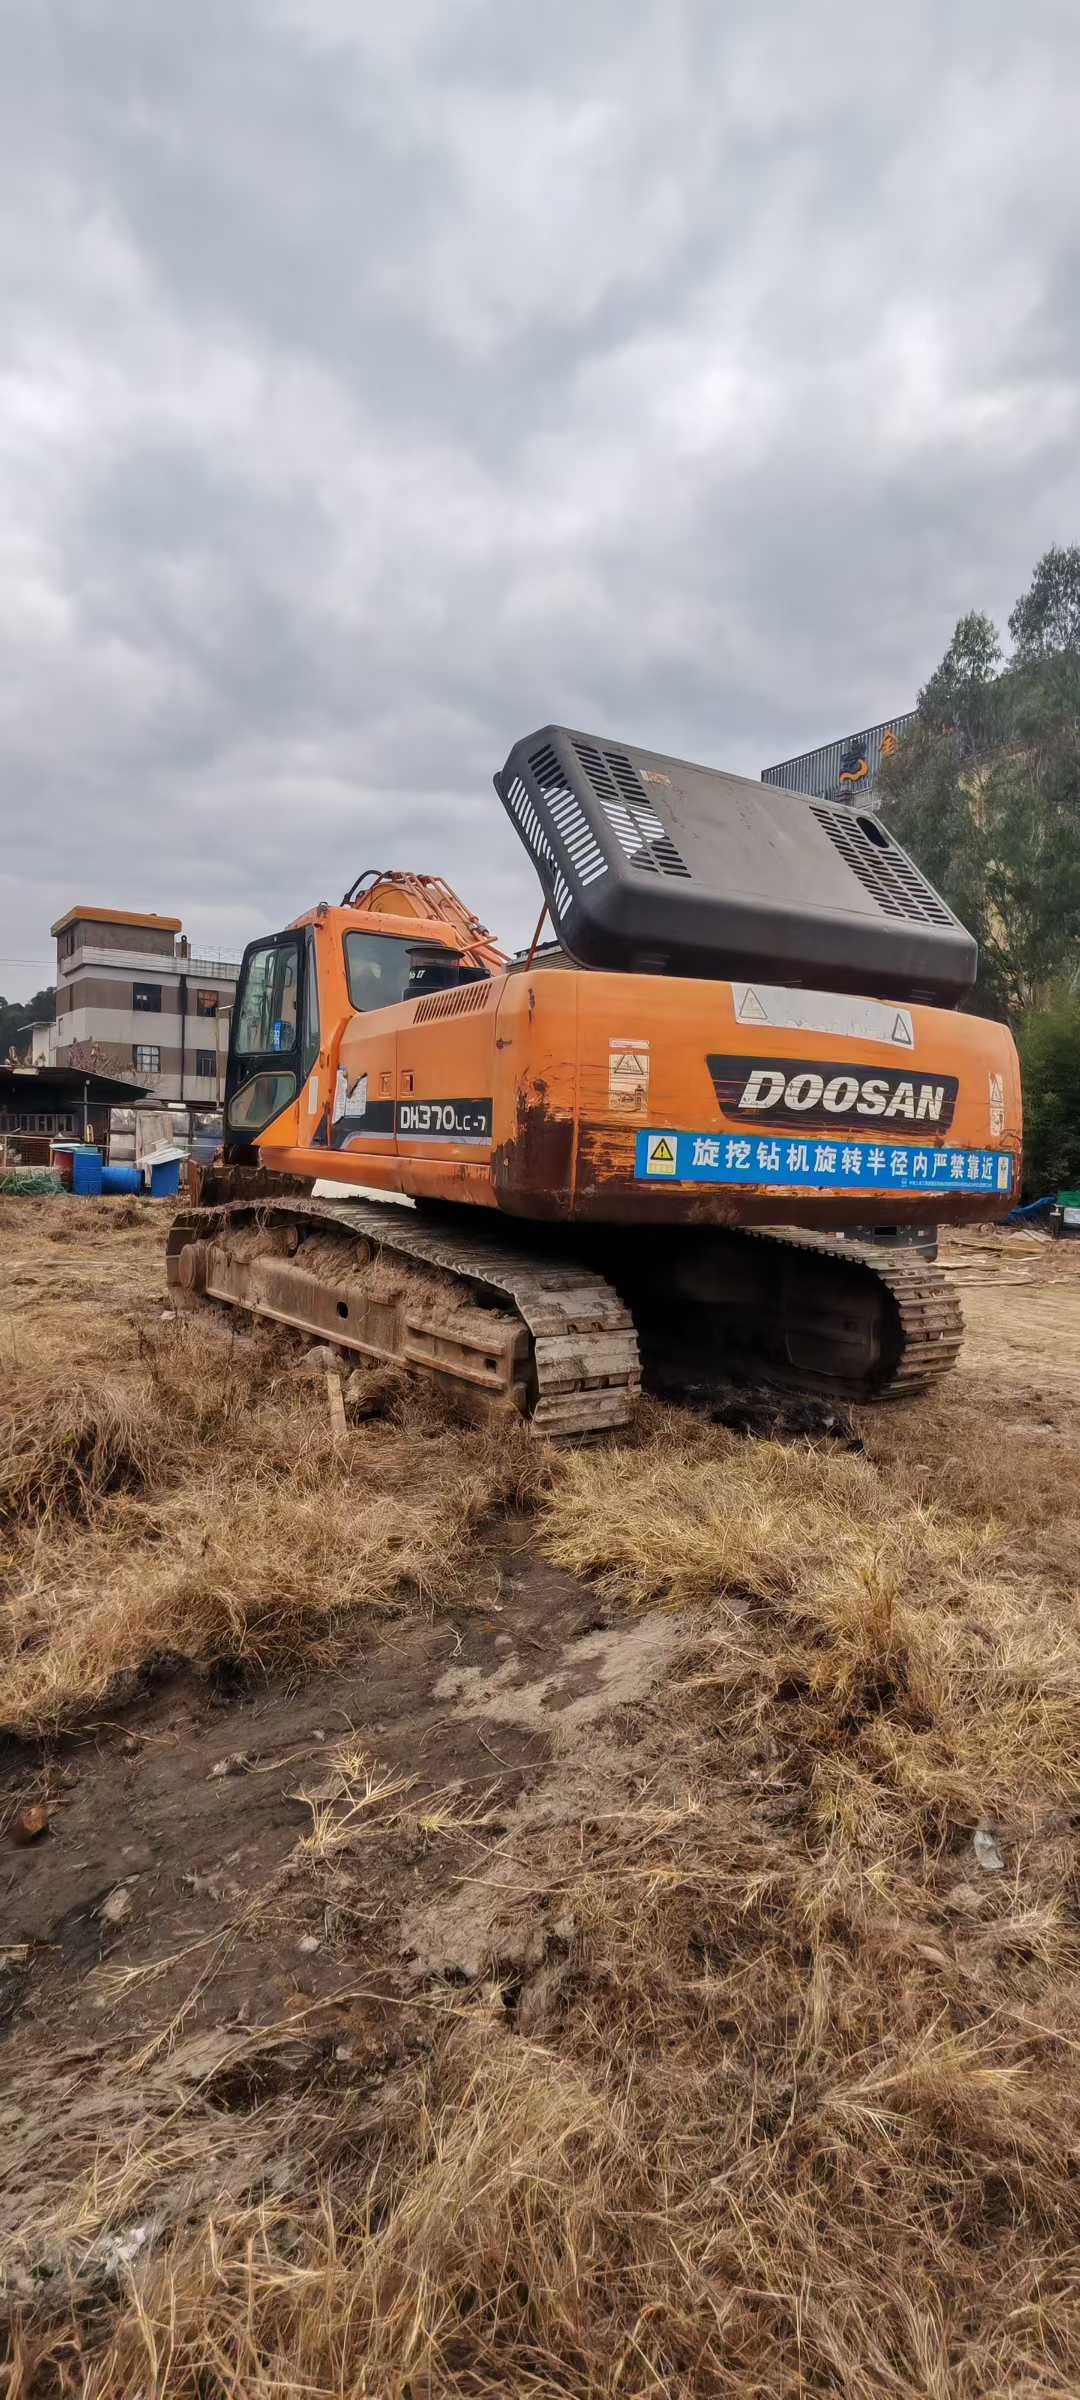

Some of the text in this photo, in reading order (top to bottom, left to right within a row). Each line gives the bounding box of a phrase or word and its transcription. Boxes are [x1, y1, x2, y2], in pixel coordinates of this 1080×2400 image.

[738, 1070, 945, 1121] DOOSAN
[692, 1138, 993, 1180] 旋挖钻机旋转半径内严禁靠近
